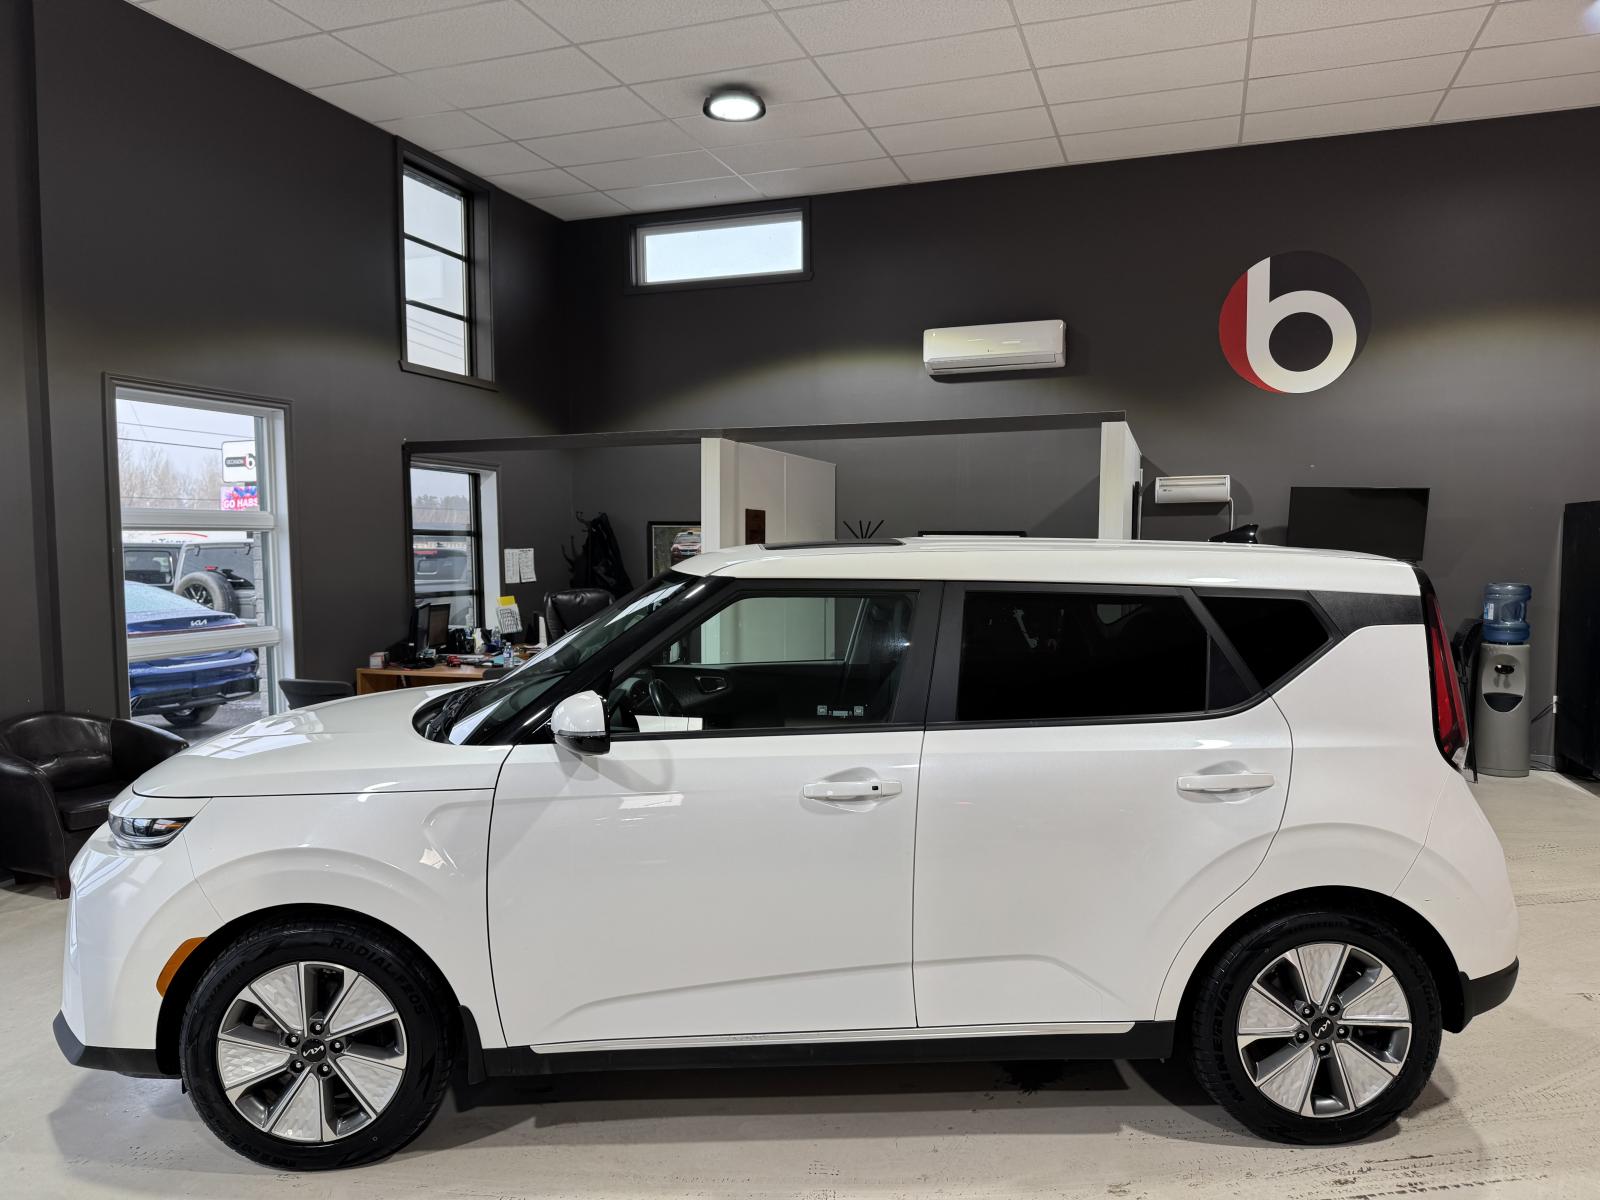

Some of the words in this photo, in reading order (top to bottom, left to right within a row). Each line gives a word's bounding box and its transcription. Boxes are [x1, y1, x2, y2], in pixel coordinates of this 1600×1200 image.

[224, 499, 235, 508] GO
[329, 938, 395, 975] RADIAL
[1314, 1019, 1331, 1037] KIA
[303, 1044, 324, 1057] KIA
[1212, 982, 1242, 1102] MINERVA
